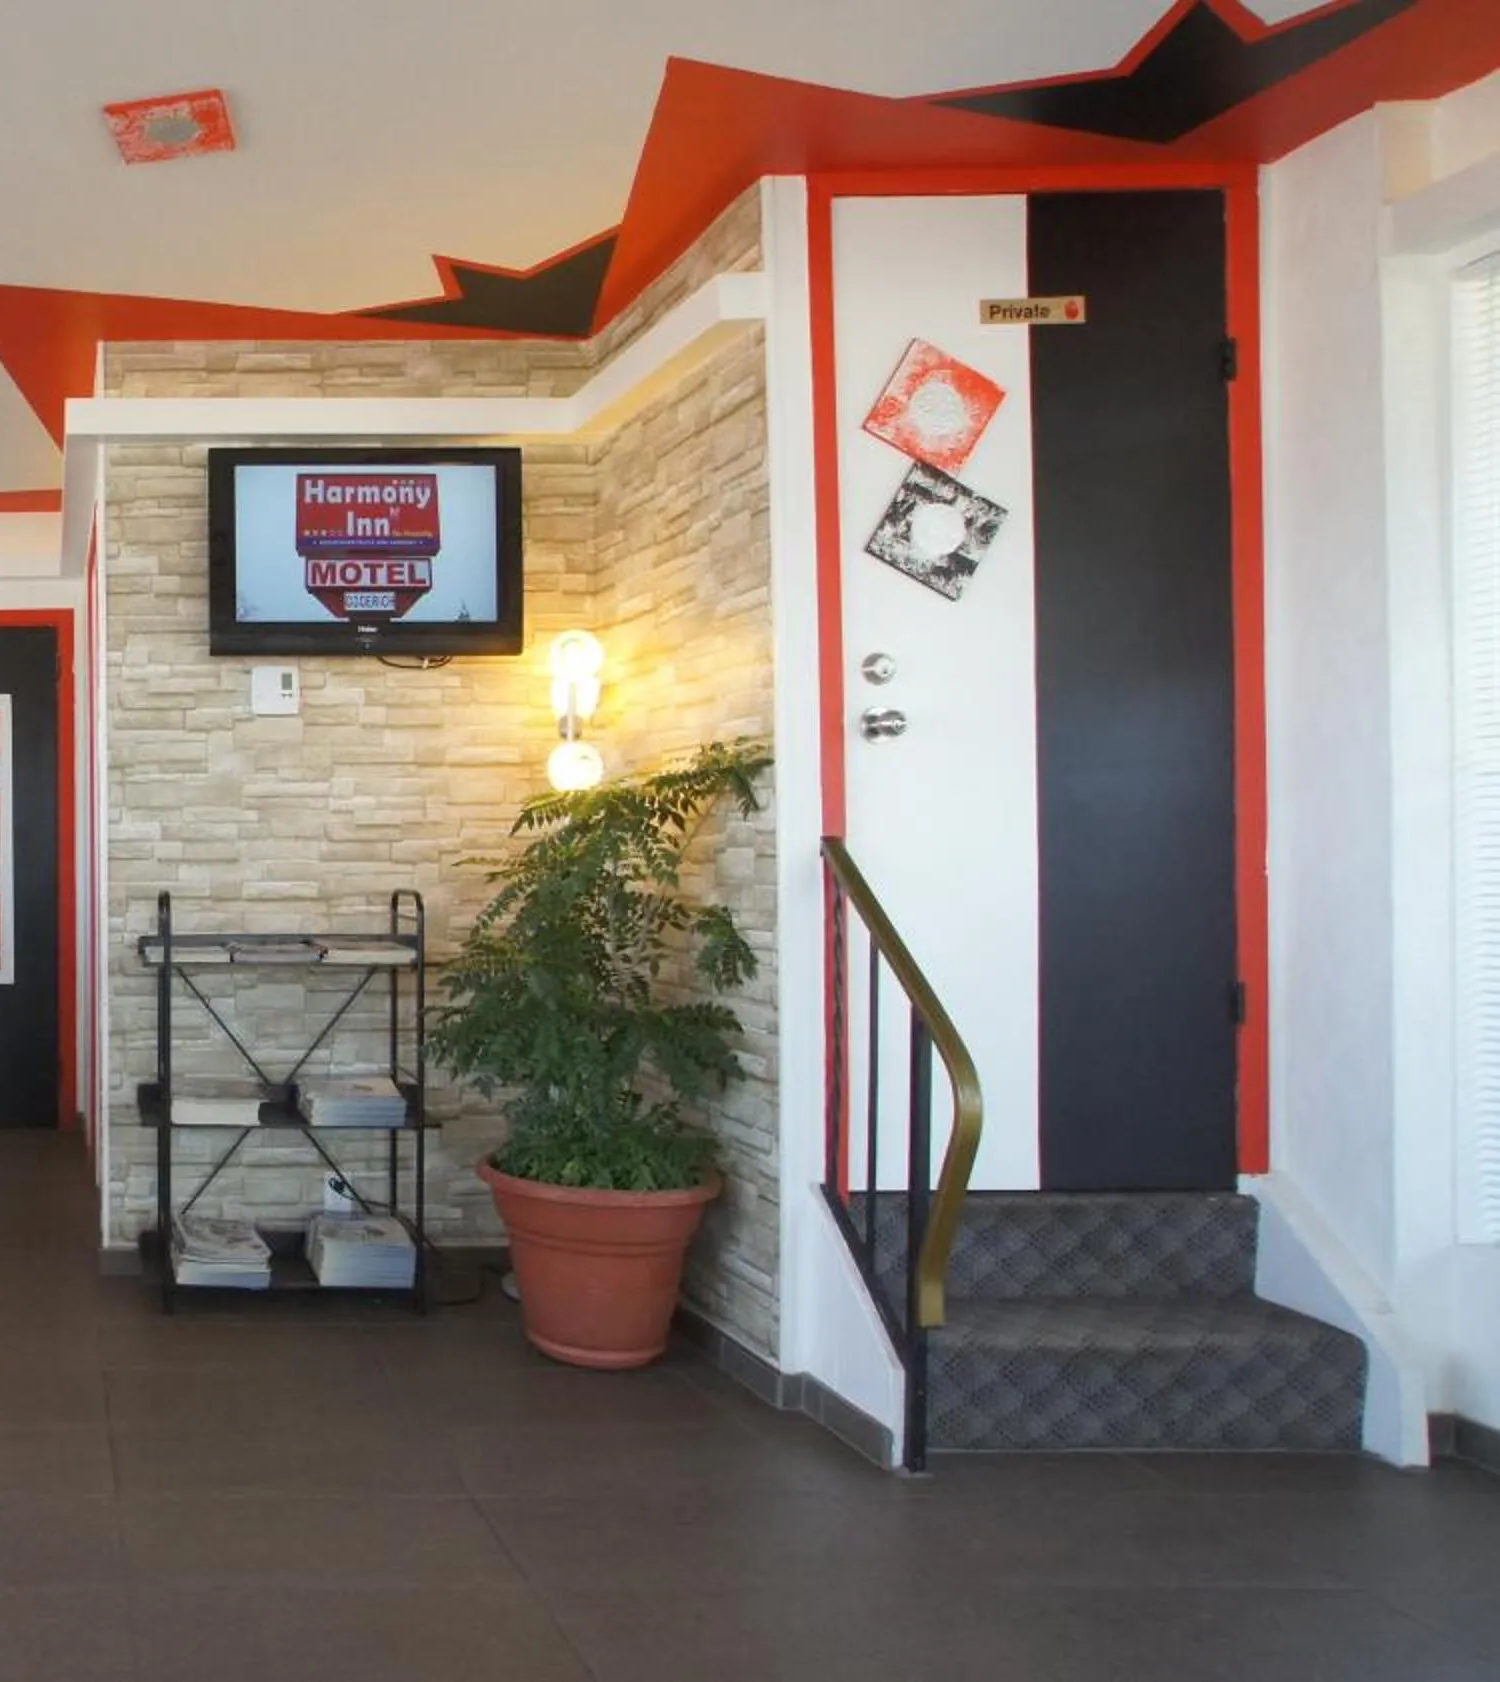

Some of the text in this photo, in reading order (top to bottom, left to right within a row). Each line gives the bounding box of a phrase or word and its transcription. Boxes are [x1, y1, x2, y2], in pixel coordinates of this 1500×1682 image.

[989, 304, 1051, 321] Private
[304, 479, 431, 509] Harmony
[347, 510, 390, 537] Inn
[311, 562, 426, 585] MOTEL
